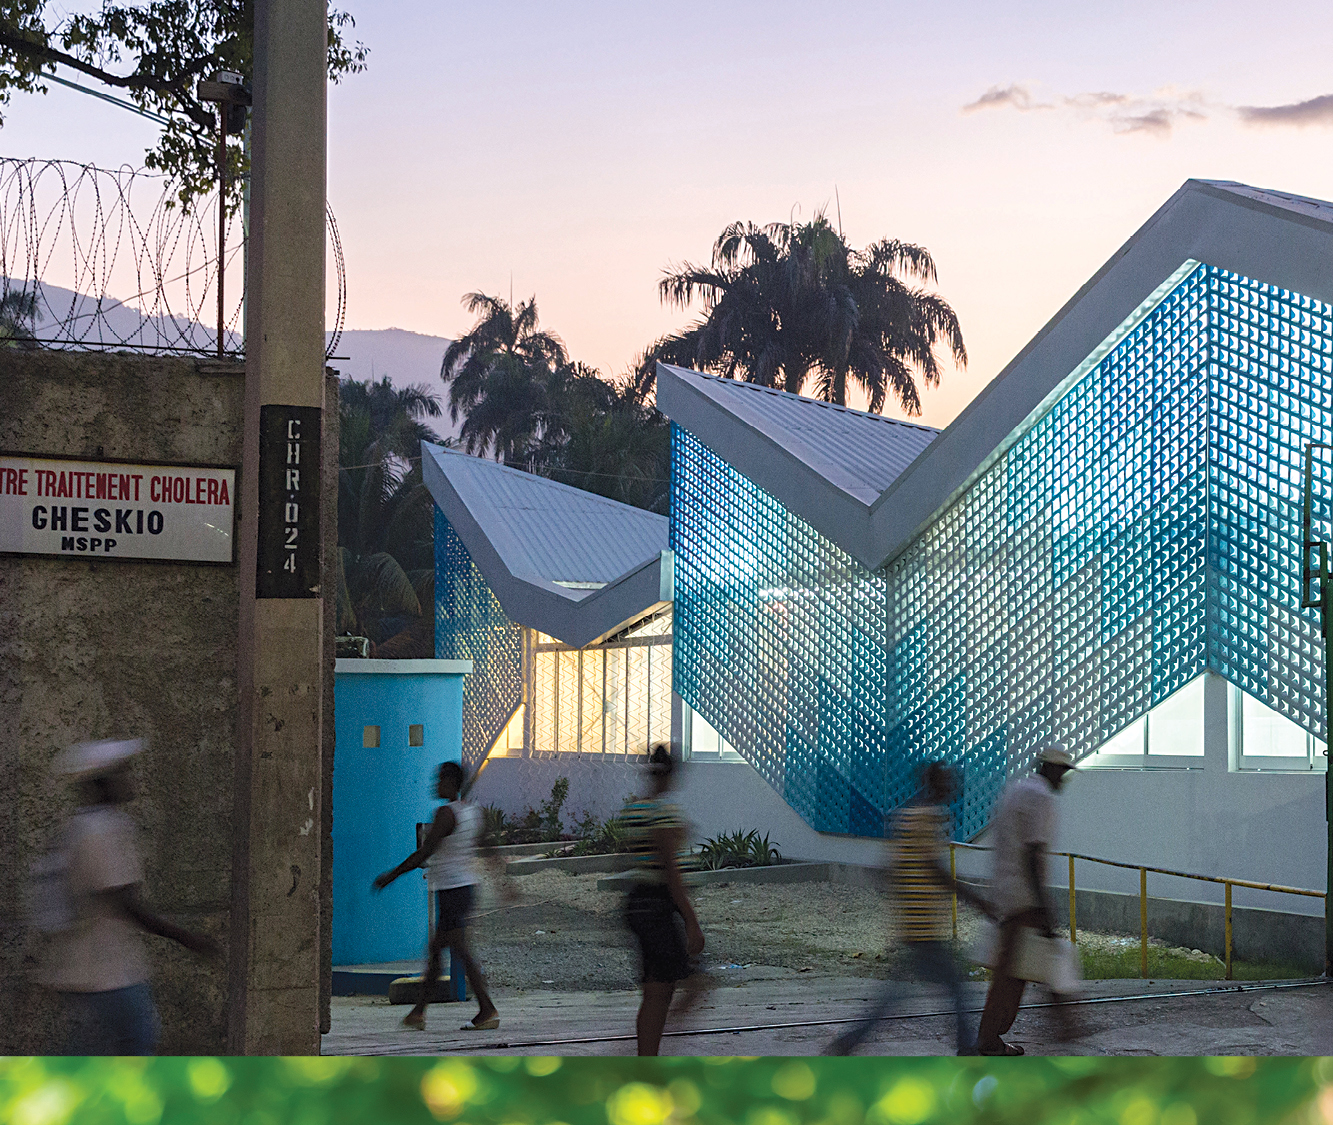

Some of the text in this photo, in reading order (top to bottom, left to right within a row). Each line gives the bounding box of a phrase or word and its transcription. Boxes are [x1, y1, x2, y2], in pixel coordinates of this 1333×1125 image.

[35, 469, 143, 502] TRAITEMENT
[150, 475, 231, 506] CHOLERA
[32, 505, 165, 536] GHESKIO
[61, 536, 118, 553] MSPP
